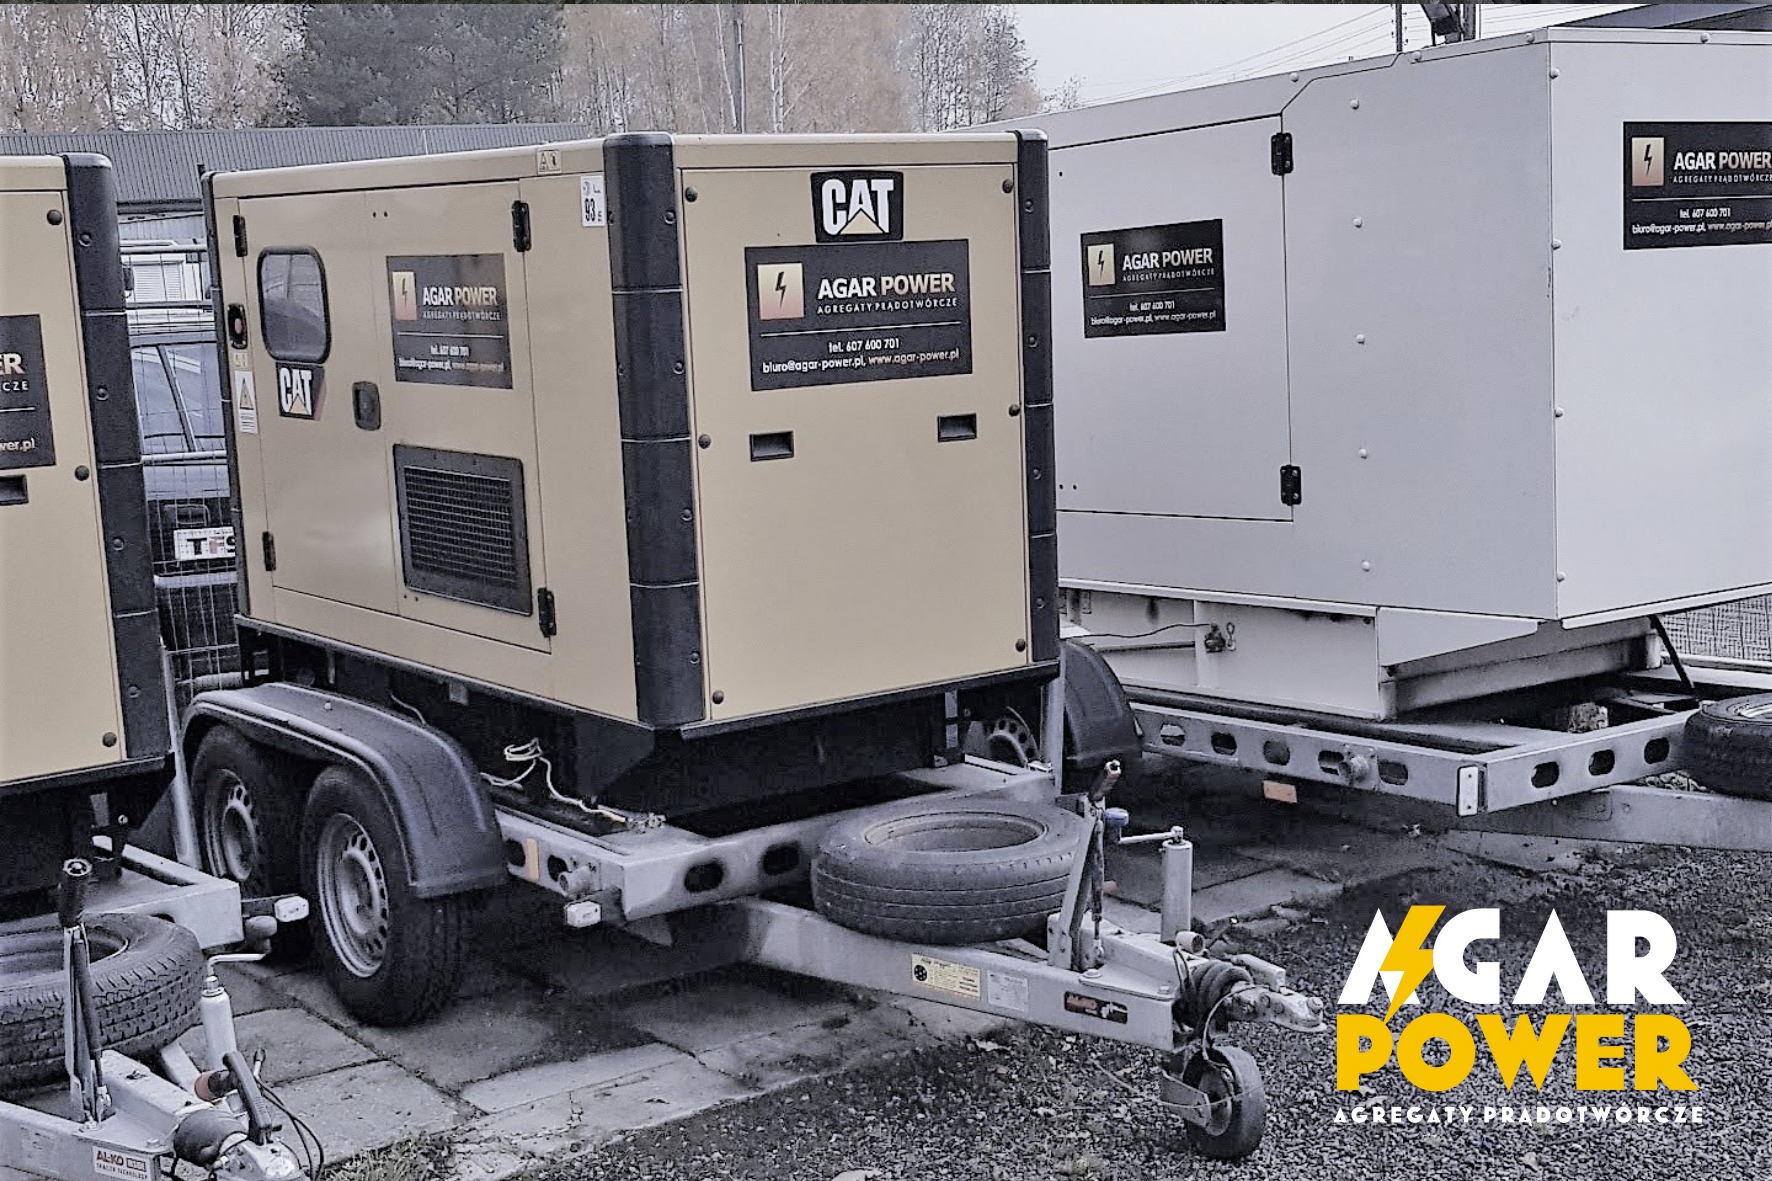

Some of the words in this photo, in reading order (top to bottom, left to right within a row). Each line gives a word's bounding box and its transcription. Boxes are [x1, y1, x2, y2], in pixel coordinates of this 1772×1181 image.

[1674, 151, 1716, 170] AGAR
[1719, 151, 1772, 169] POWER
[584, 198, 596, 221] 93
[821, 178, 894, 236] CAT
[1122, 254, 1160, 271] AGAR
[1162, 248, 1213, 267] POWER
[422, 286, 453, 306] AGAR
[454, 286, 498, 306] POWER
[817, 278, 877, 300] AGAR
[880, 273, 956, 295] POWER
[817, 303, 872, 314] AGREGATY
[828, 342, 843, 354] tel.
[846, 340, 863, 352] 607
[865, 339, 882, 350] 600
[884, 338, 900, 349] 701
[280, 367, 313, 416] CAT
